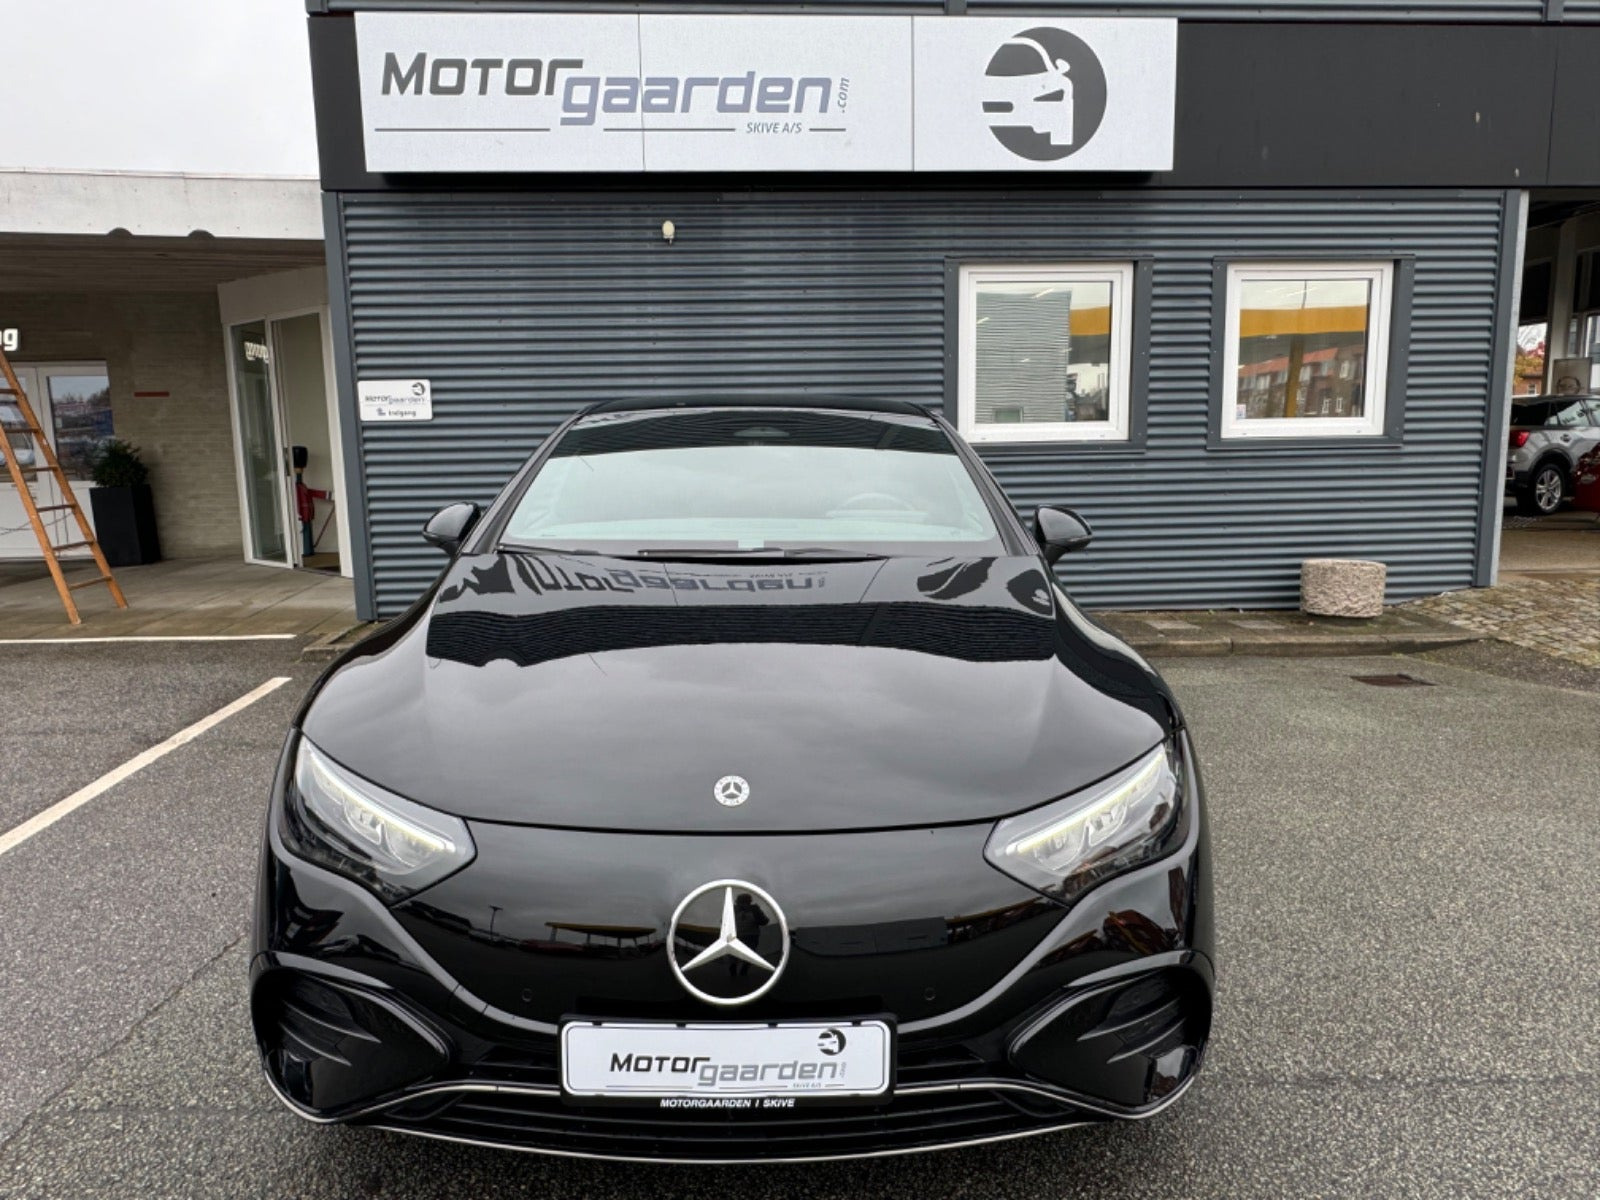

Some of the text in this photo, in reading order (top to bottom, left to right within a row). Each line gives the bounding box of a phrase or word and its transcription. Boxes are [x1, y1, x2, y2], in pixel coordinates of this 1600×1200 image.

[837, 77, 850, 114] .com
[745, 121, 803, 134] SKIVE A/S
[660, 1098, 752, 1108] MOTORGAARDEN
[762, 1098, 796, 1108] SKIVE
